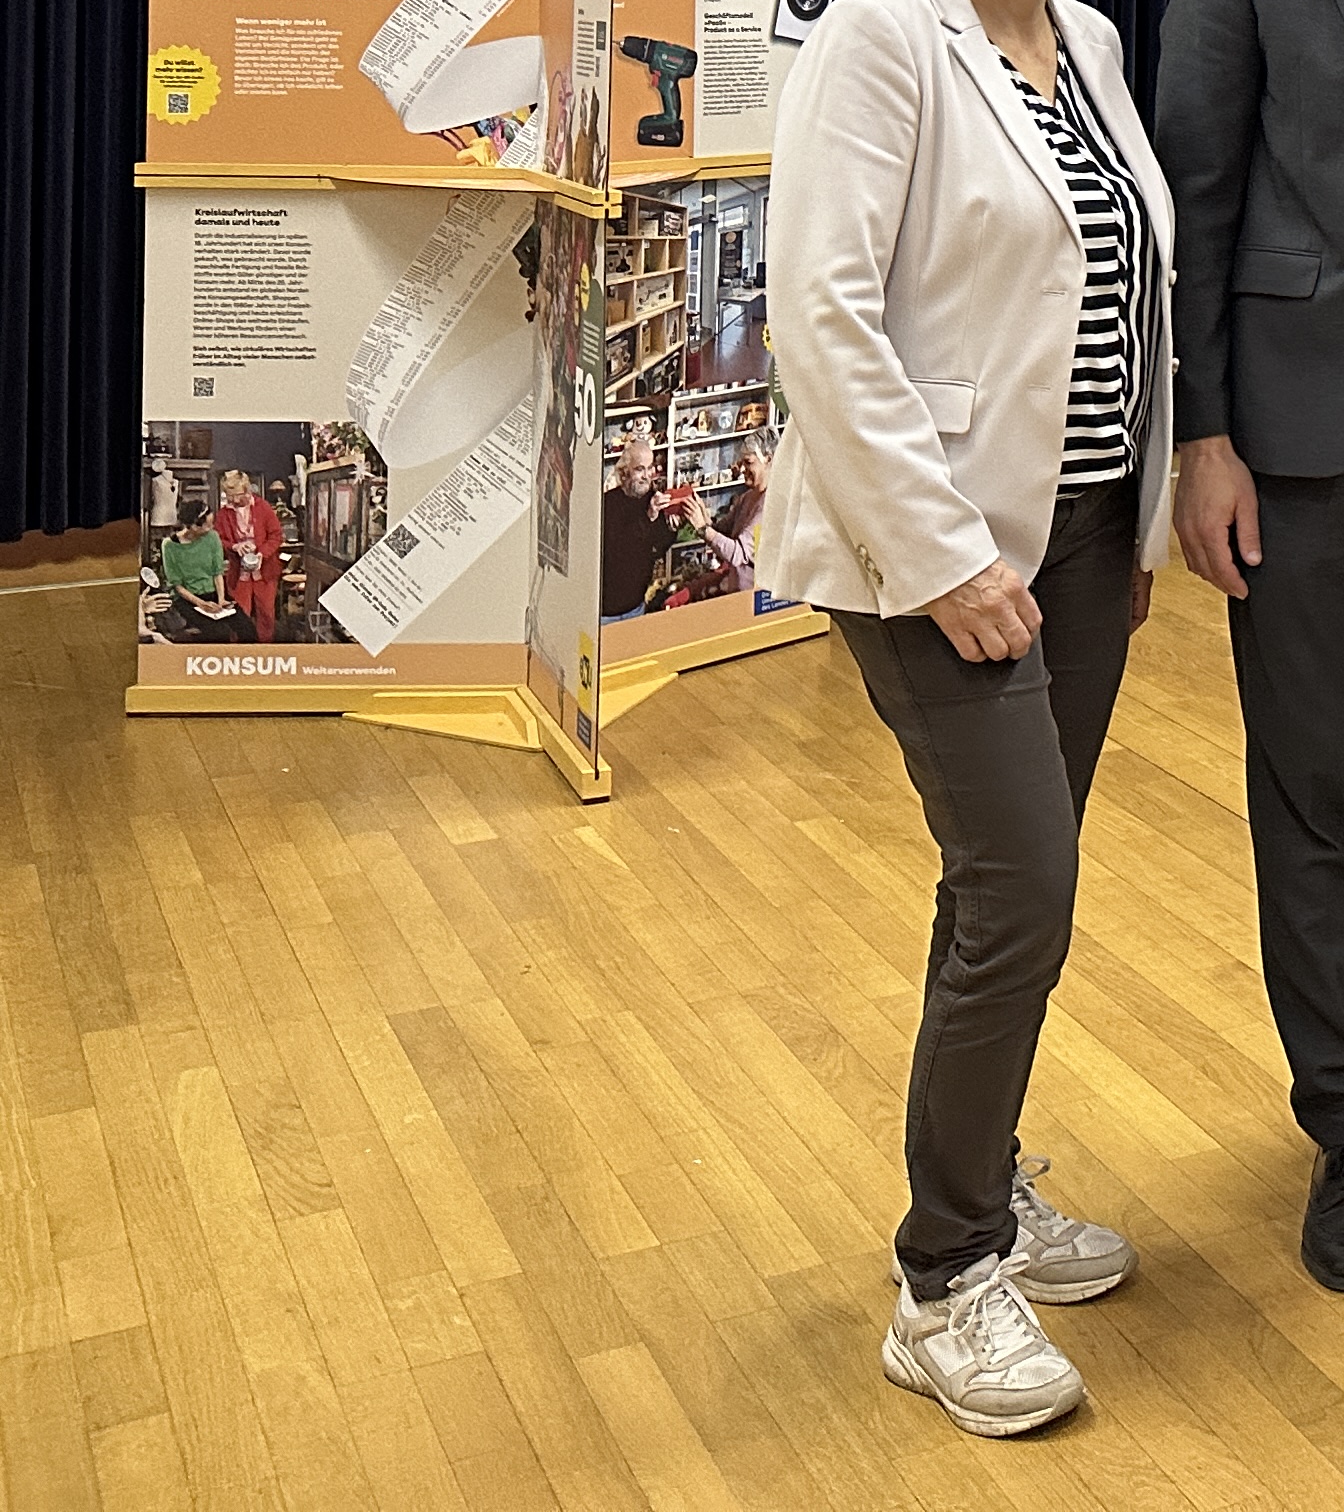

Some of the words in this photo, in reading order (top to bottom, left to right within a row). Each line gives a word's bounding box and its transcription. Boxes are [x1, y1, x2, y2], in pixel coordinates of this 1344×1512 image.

[194, 208, 288, 217] Kreislaufwirtschaft
[194, 218, 230, 226] damals
[232, 218, 250, 226] und
[252, 218, 281, 226] heute
[573, 365, 596, 446] 50
[186, 656, 297, 676] KONSUM
[302, 666, 397, 676] Weiterverwenden
